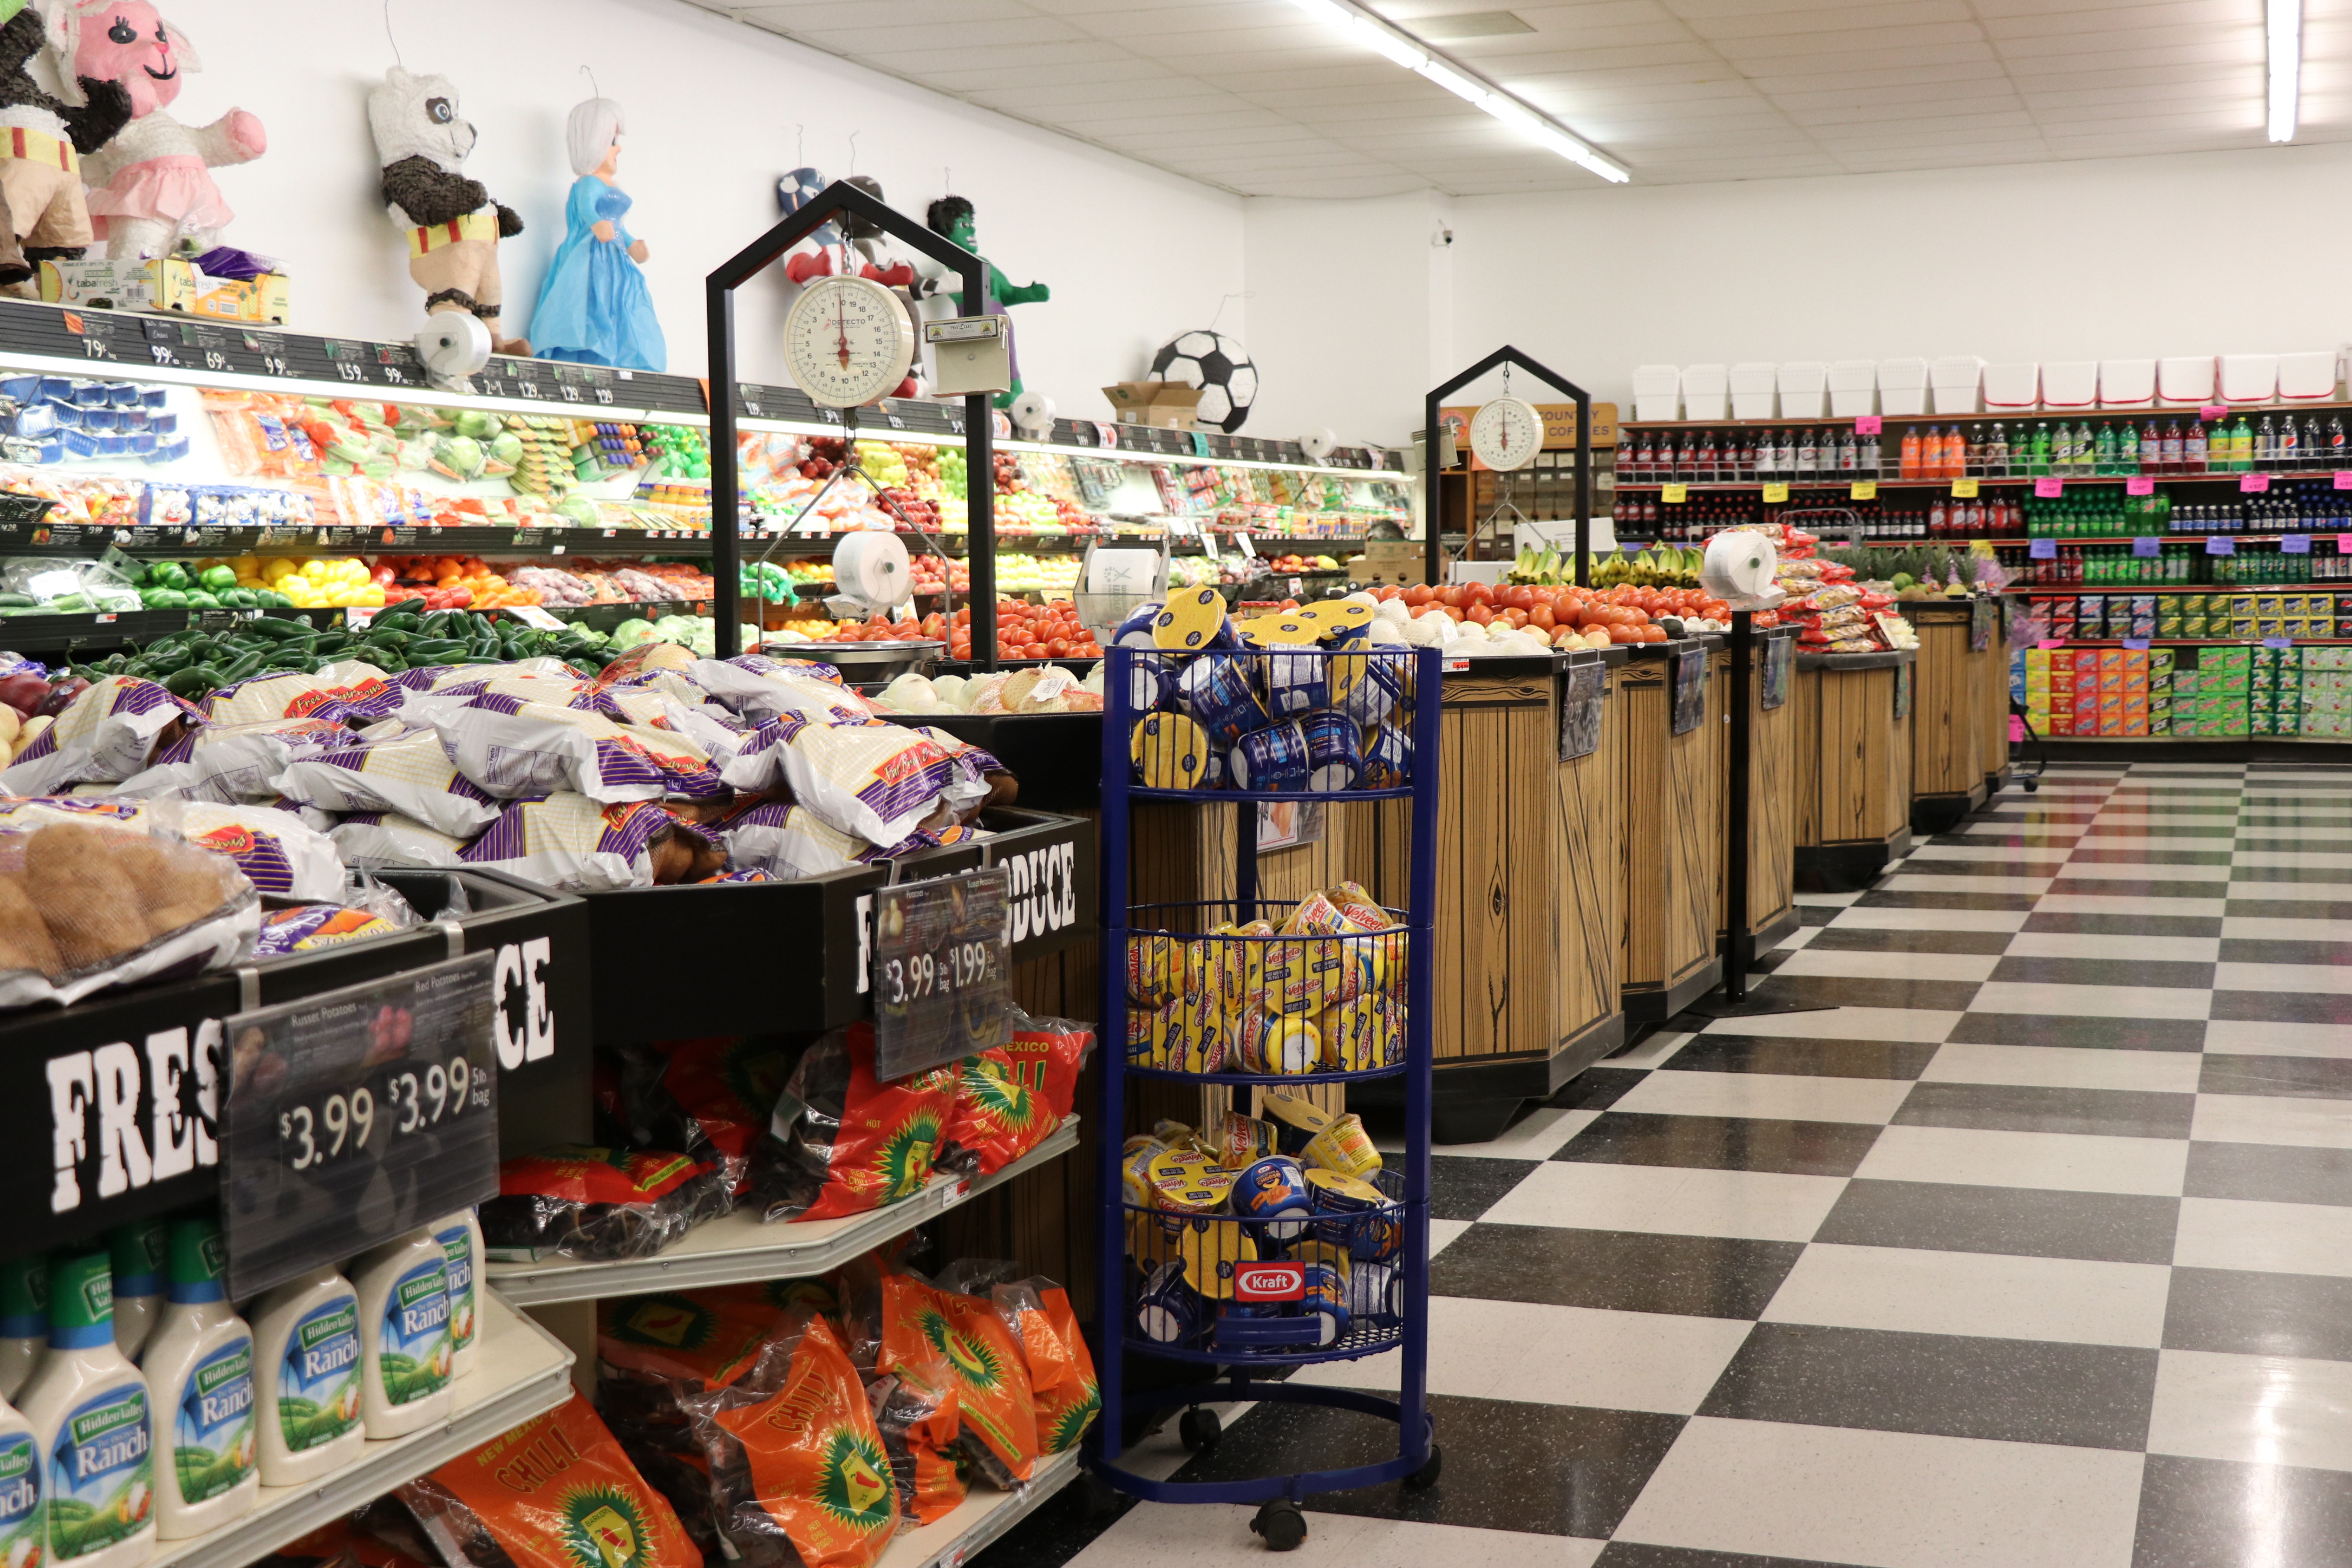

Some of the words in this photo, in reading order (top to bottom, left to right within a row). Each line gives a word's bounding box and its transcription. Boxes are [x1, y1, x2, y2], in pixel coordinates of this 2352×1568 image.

[77, 279, 118, 288] tabafresh
[180, 277, 213, 290] tabafresh
[1549, 426, 1609, 436] COFES
[296, 694, 323, 713] Free
[884, 763, 900, 781] Fat
[979, 877, 995, 886] Potatoes
[906, 889, 924, 899] Potatoes
[950, 941, 985, 988] $1.99
[987, 965, 997, 979] bag
[415, 980, 430, 993] Red
[431, 972, 460, 989] Potatoes
[887, 953, 934, 1004] $3.99
[939, 978, 950, 993] bag
[292, 1012, 320, 1027] Russet
[321, 1002, 357, 1020] Potatoes
[390, 1056, 469, 1133] $3.99
[473, 1087, 489, 1106] bag
[46, 1018, 222, 1214] FRES
[866, 1119, 881, 1129] HOT
[281, 1087, 374, 1170] $3.99
[1172, 1152, 1203, 1164] Velveeta
[848, 1177, 868, 1185] CHILI
[850, 1169, 865, 1178] RED
[1201, 1177, 1230, 1187] Velveeta
[453, 1243, 468, 1256] Valley
[92, 1277, 113, 1295] Hid
[449, 1264, 471, 1291] nch
[1253, 1275, 1288, 1288] Kraft
[406, 1279, 432, 1299] Hidden
[403, 1293, 450, 1336] Ranch
[308, 1320, 338, 1341] Hidden
[338, 1313, 355, 1329] Valley
[305, 1335, 358, 1379] Ranch
[204, 1363, 236, 1385] Hidden
[201, 1379, 253, 1428] Ranch
[766, 1370, 838, 1433] CHILI
[81, 1413, 121, 1435] Hidden
[121, 1403, 145, 1423] Valley
[77, 1425, 149, 1476] Ranch
[476, 1440, 505, 1466] NEW
[495, 1423, 581, 1494] CHILI
[937, 1464, 948, 1475] RED
[769, 1478, 796, 1494] EXTRA
[781, 1486, 797, 1498] HOT
[930, 1482, 948, 1491] PODS
[808, 1519, 822, 1531] RED
[810, 1527, 828, 1541] CHILI
[816, 1535, 834, 1551] PODS
